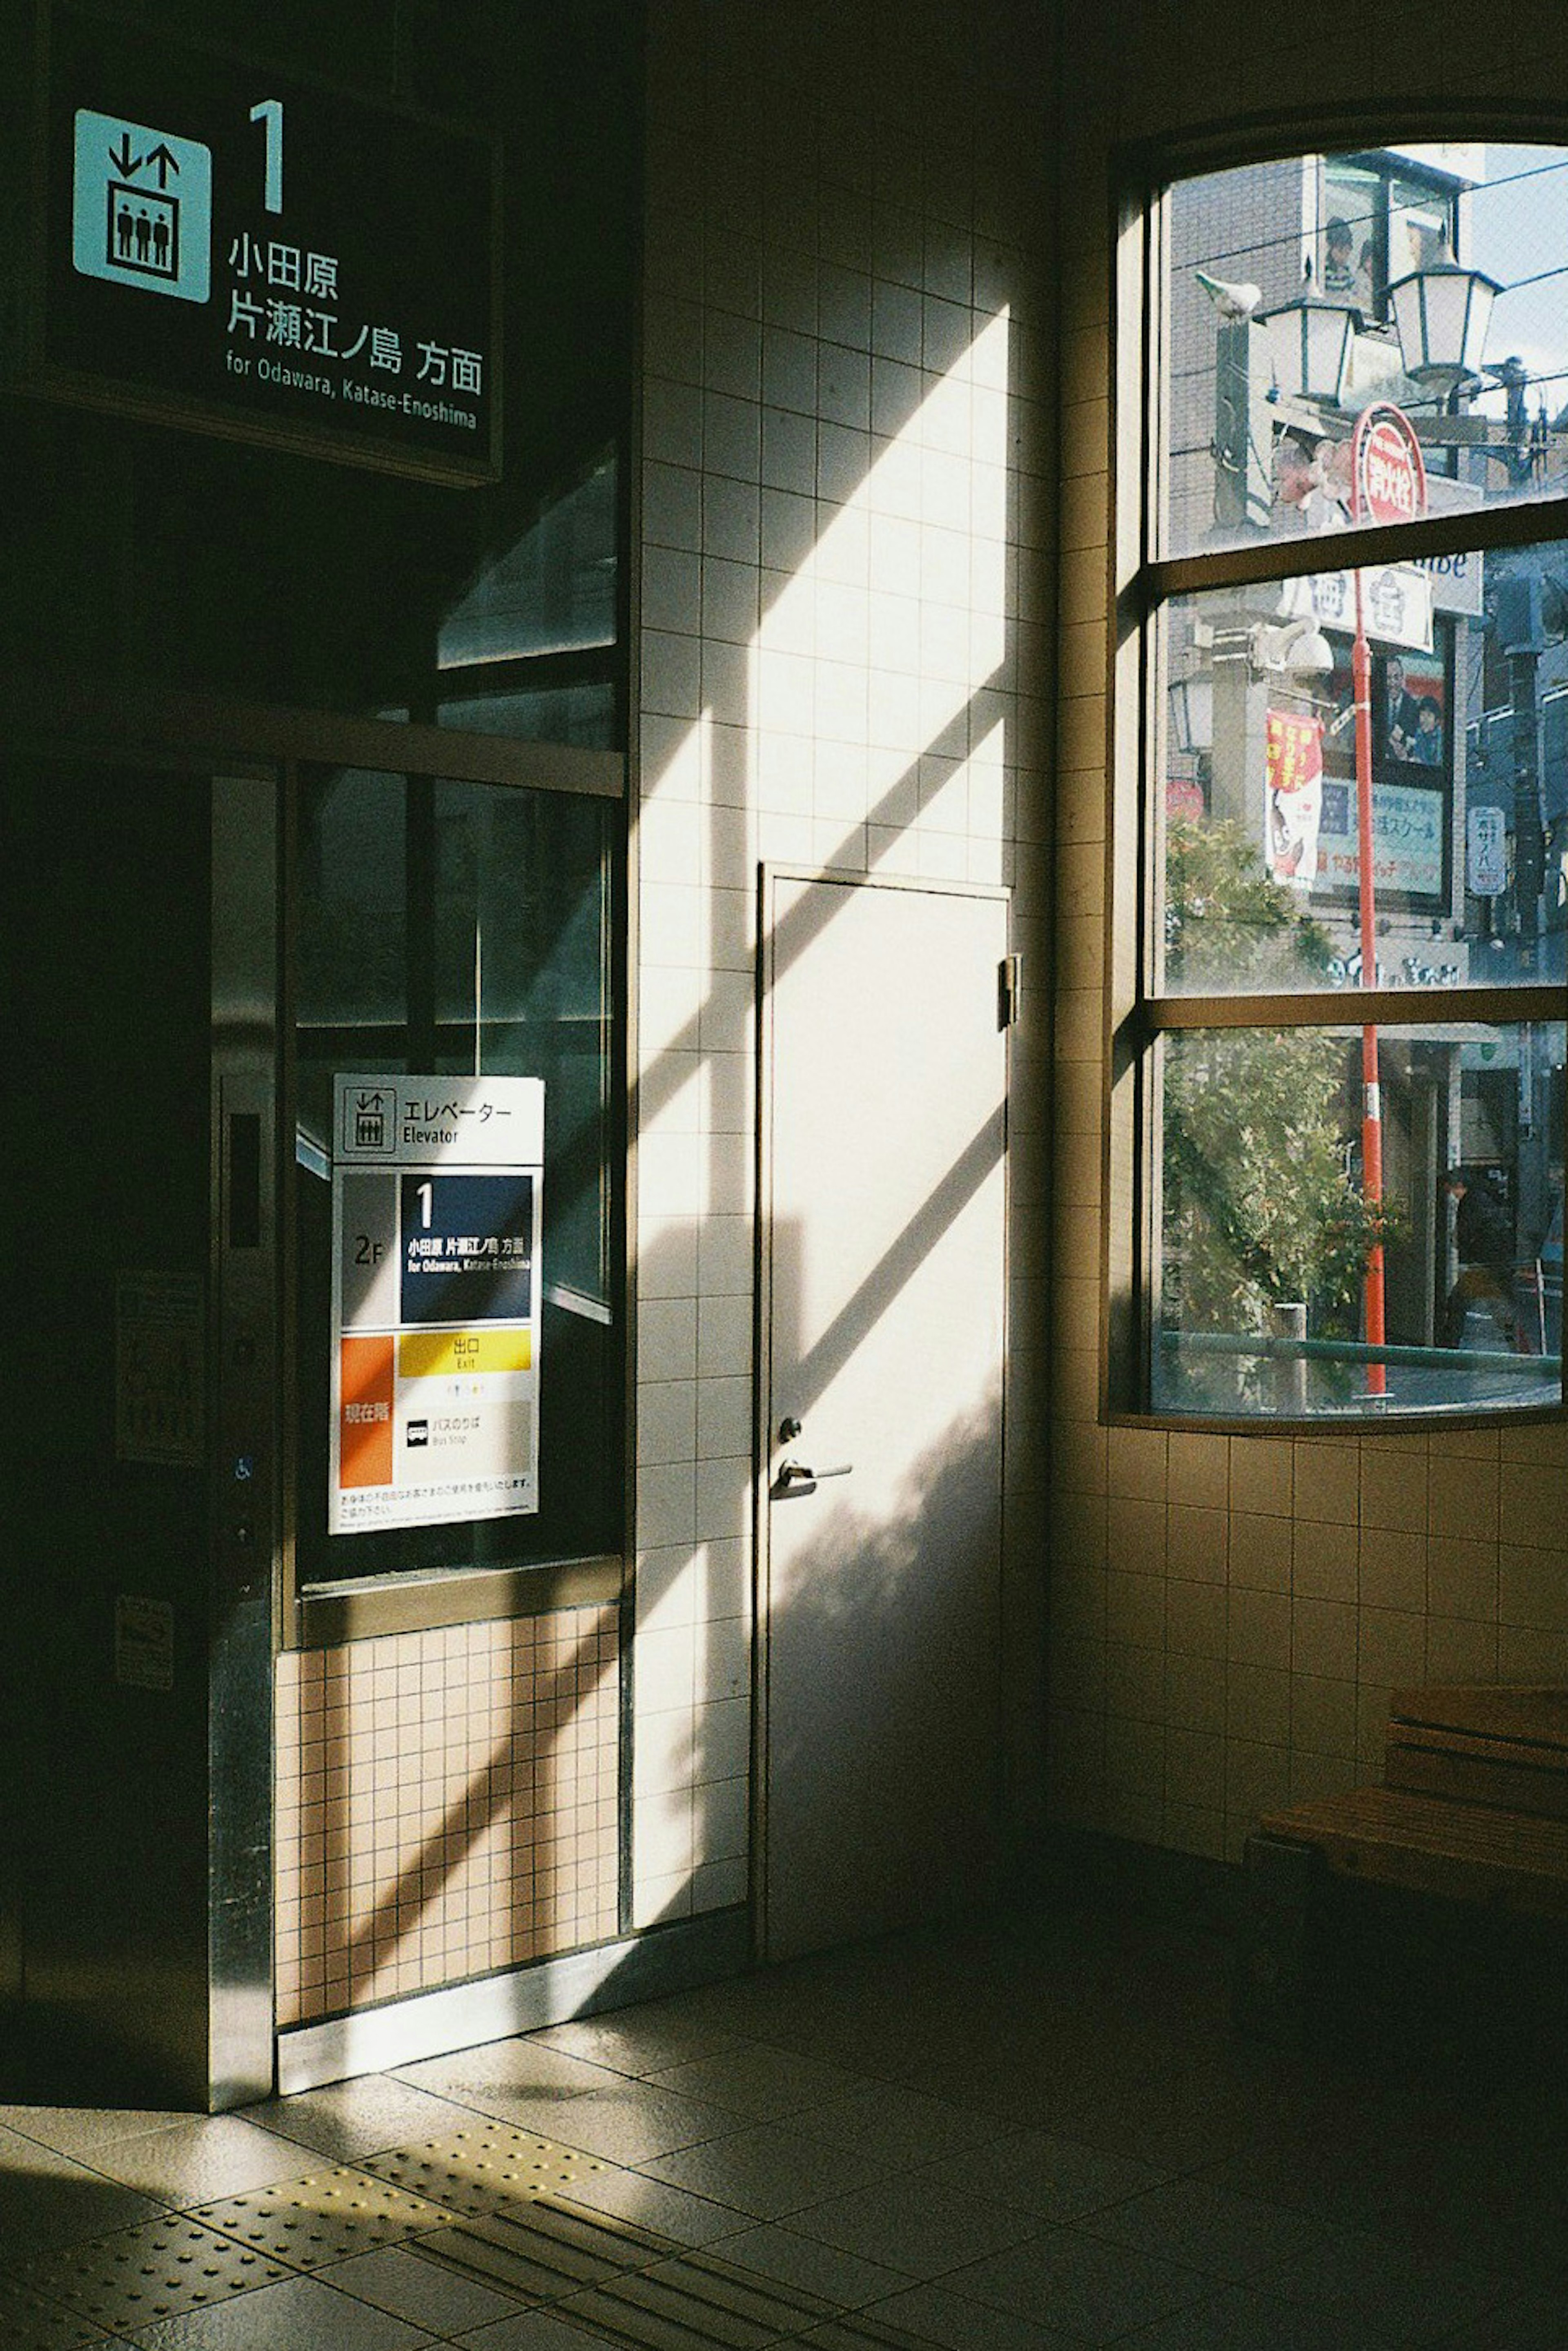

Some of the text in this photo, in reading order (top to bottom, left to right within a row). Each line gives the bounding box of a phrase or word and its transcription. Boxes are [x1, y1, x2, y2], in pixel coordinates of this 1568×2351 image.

[250, 99, 283, 214] 1
[228, 232, 338, 300] 小田原
[227, 288, 483, 395] 片瀬江ノ島 方面
[226, 350, 477, 429] for Odawara, Katase-Enoshima
[404, 1101, 512, 1122] エレベーター
[403, 1127, 458, 1143] Elevator
[416, 1182, 432, 1229] 1
[355, 1236, 382, 1263] 2F
[408, 1238, 444, 1257] 小田原
[502, 1237, 524, 1255] 方面
[408, 1259, 421, 1272] for
[423, 1259, 462, 1273] Odawara,
[454, 1338, 479, 1354] 出口
[457, 1358, 475, 1369] Exit
[345, 1402, 390, 1423] 現在階
[432, 1416, 480, 1432] バスのりば
